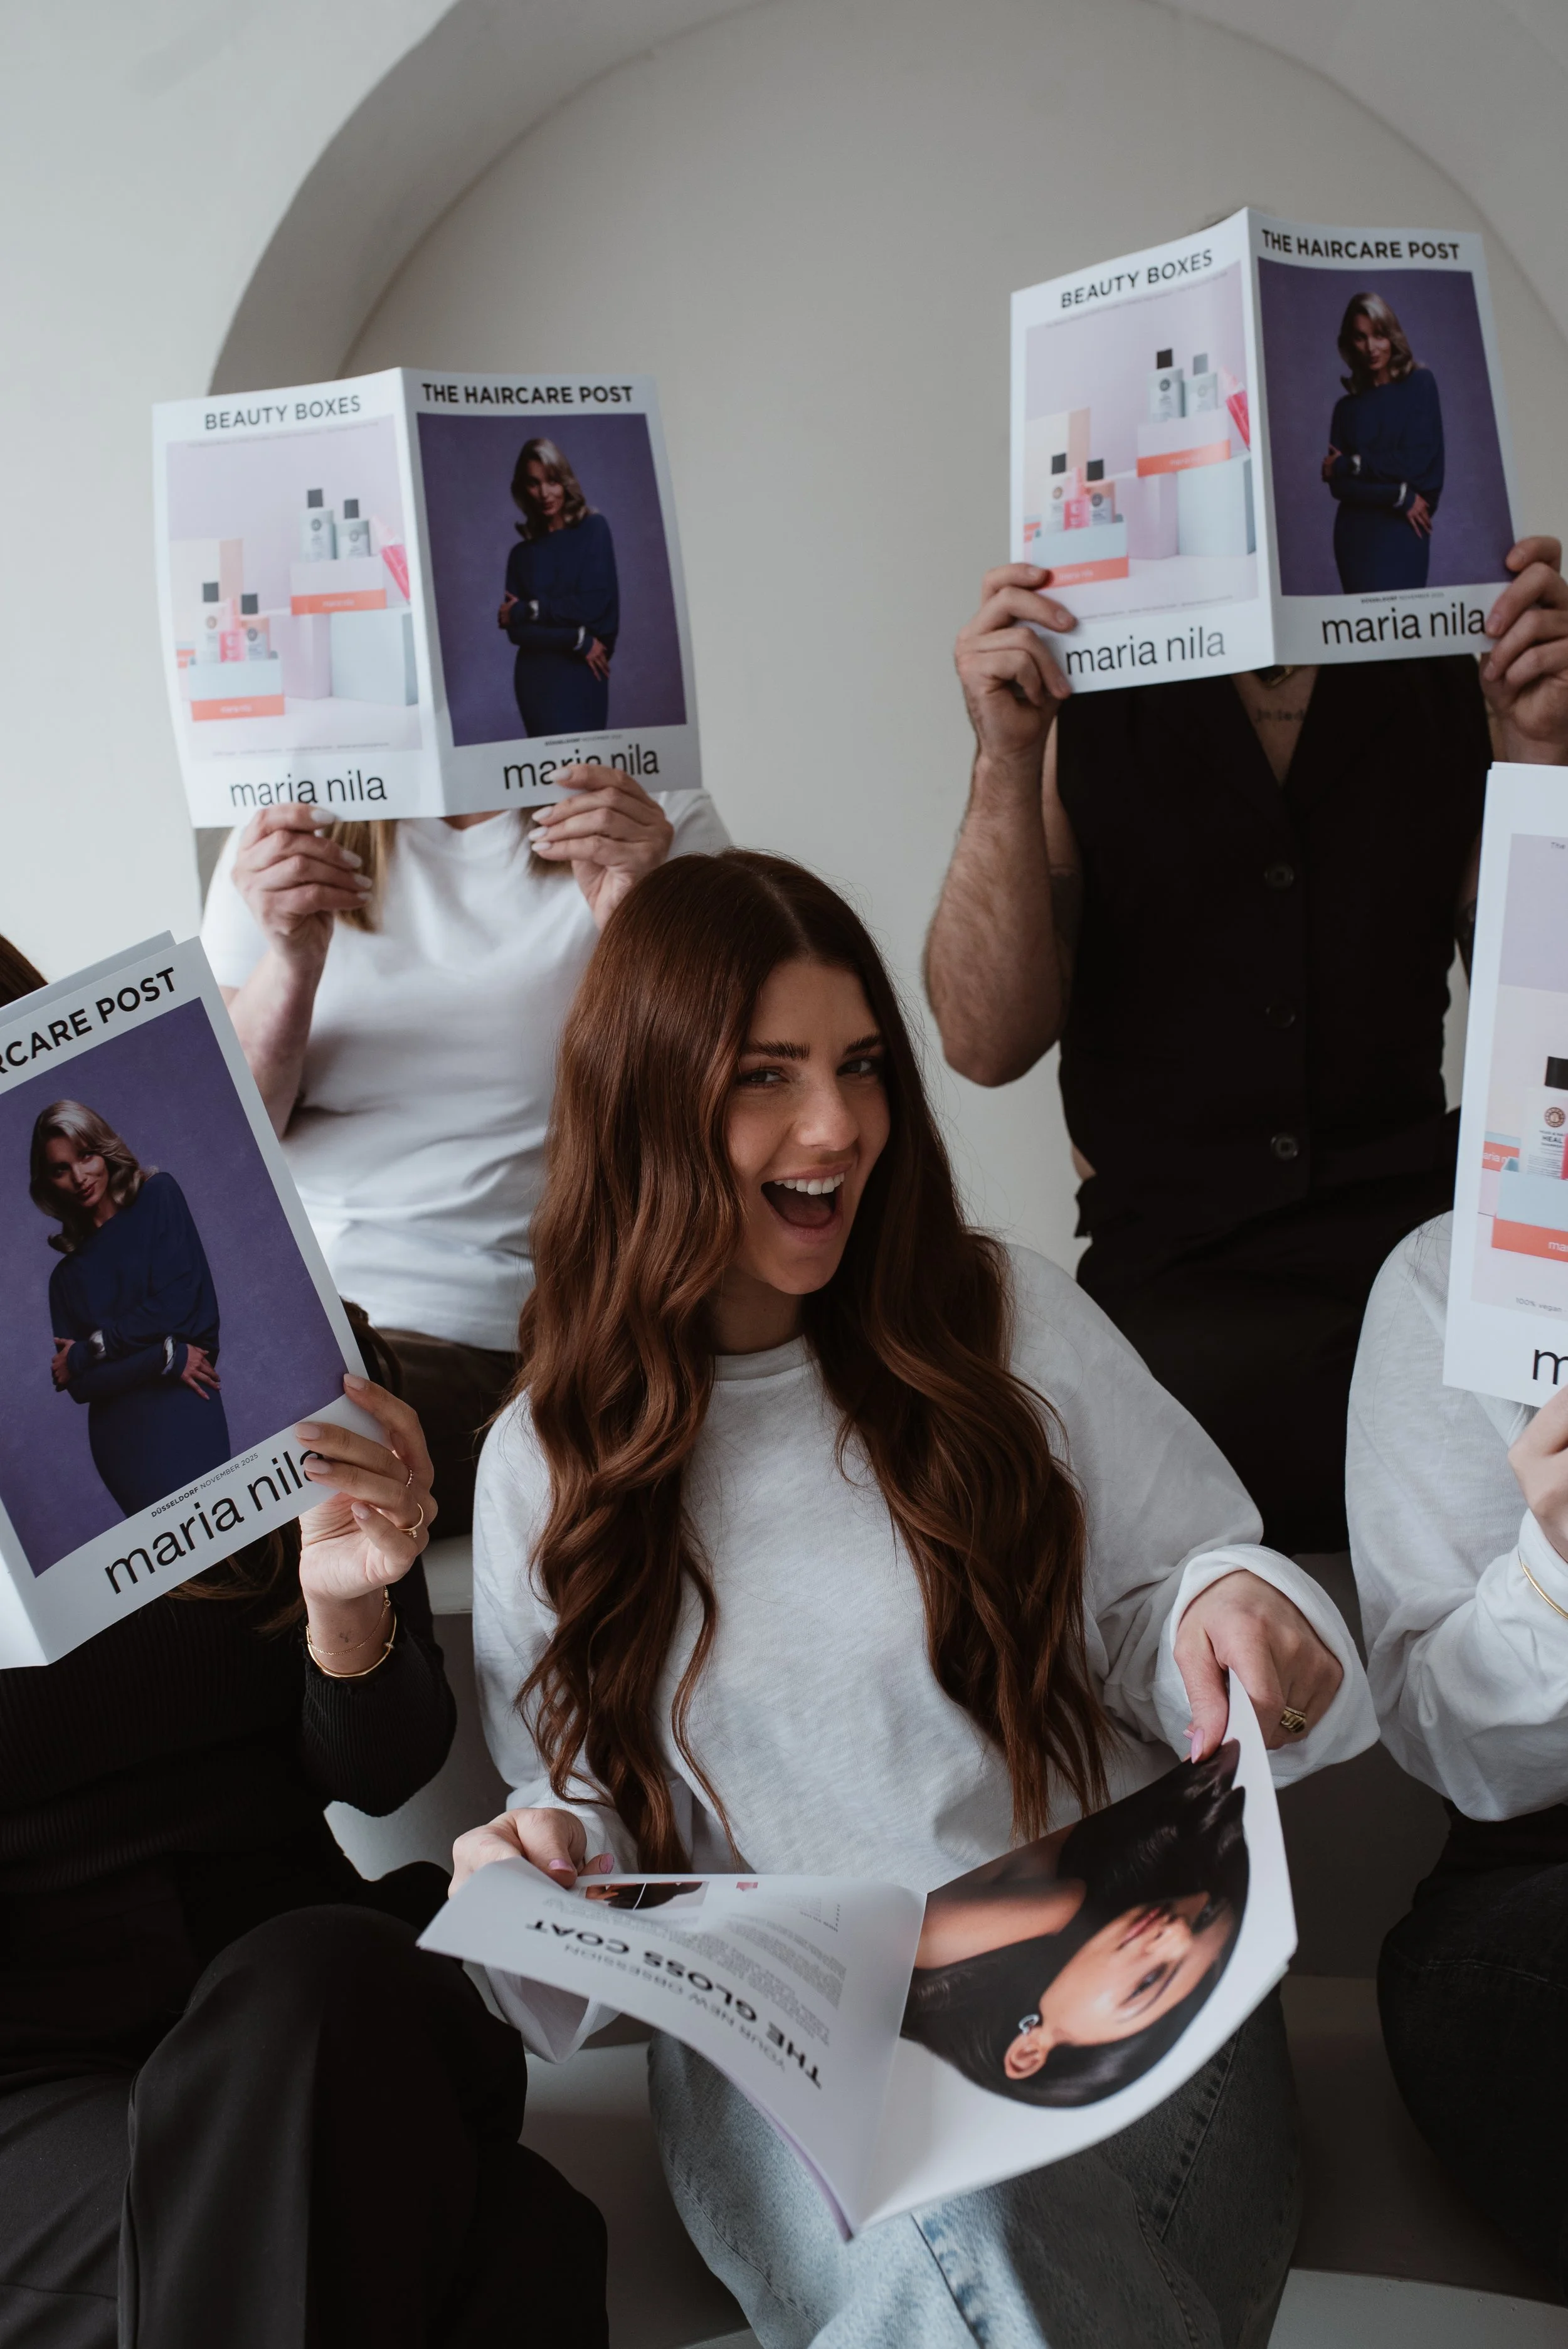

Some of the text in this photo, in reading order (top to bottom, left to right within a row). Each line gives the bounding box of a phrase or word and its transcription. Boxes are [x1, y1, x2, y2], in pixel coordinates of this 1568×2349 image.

[1262, 229, 1459, 260] THE HAIRCARE POST
[1061, 270, 1140, 309] BEAUTY
[1147, 249, 1212, 284] BOXES
[204, 395, 361, 430] BEAUTY BOXES
[422, 383, 633, 405] THE HAIRCARE POST
[1322, 602, 1486, 645] maria nila
[1066, 625, 1226, 675] maria nila
[611, 743, 660, 776] nila
[230, 769, 387, 807] maria nila
[95, 967, 174, 1024] POST
[1516, 1296, 1562, 1313] 100% vegan
[151, 1453, 258, 1517] DÜSSELDORF NOVEMBER 2025
[105, 1497, 245, 1594] maria
[526, 1919, 630, 1955] COAT
[564, 1944, 684, 1995] OBSESSION
[644, 1949, 757, 2023] GLOSS
[688, 1992, 734, 2027] NEW
[738, 2023, 785, 2074] YOUR
[766, 2020, 822, 2090] THE
